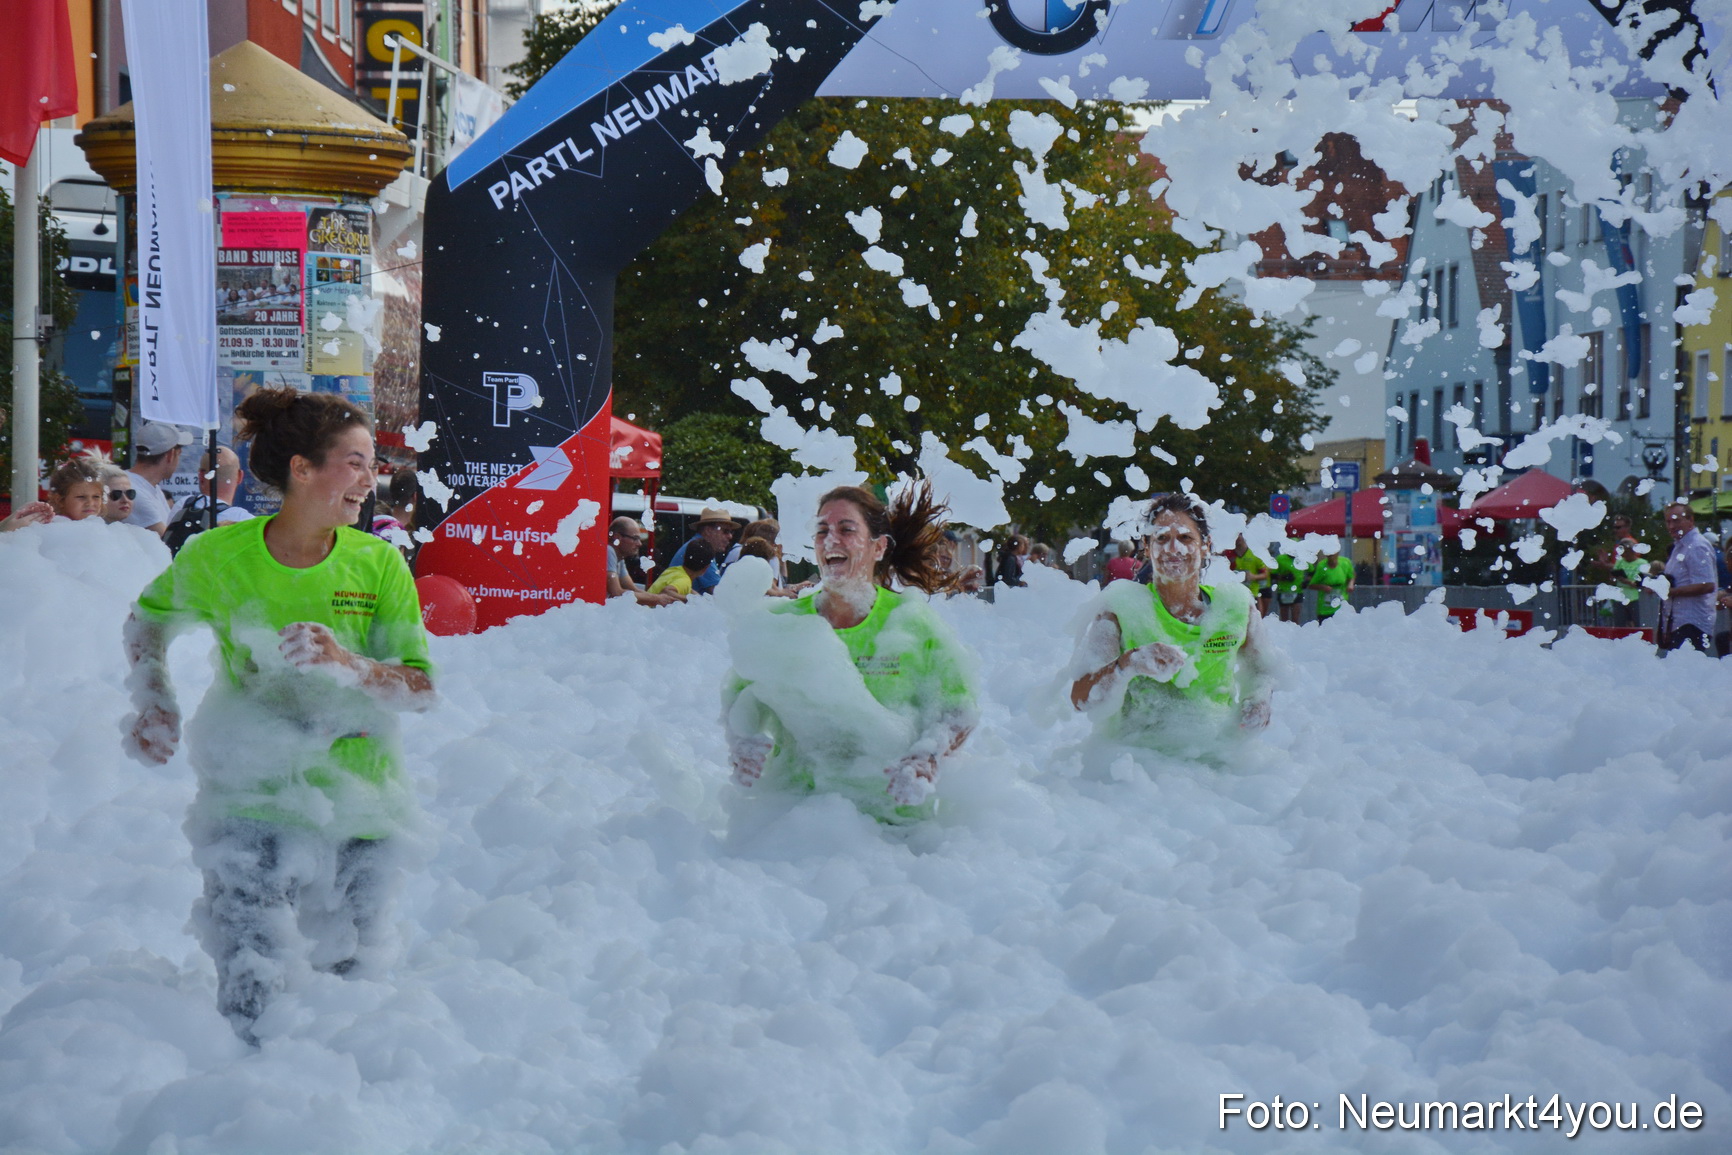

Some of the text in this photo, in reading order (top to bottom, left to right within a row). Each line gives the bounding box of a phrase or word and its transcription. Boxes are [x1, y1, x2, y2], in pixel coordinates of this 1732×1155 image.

[487, 137, 594, 211] PARTL
[218, 250, 298, 264] BAND SUNRISE
[254, 310, 299, 322] 20 JAHRE
[305, 308, 313, 331] andere
[219, 327, 265, 336] Gottesdienst
[273, 327, 299, 337] Konzert
[305, 332, 313, 345] und
[220, 337, 253, 348] 21.09.19
[262, 337, 283, 348] 18.30
[285, 337, 299, 348] Uhr
[464, 461, 523, 477] THE NEXT
[447, 474, 507, 488] 100 YEARS
[445, 523, 552, 546] BMW Laufsp
